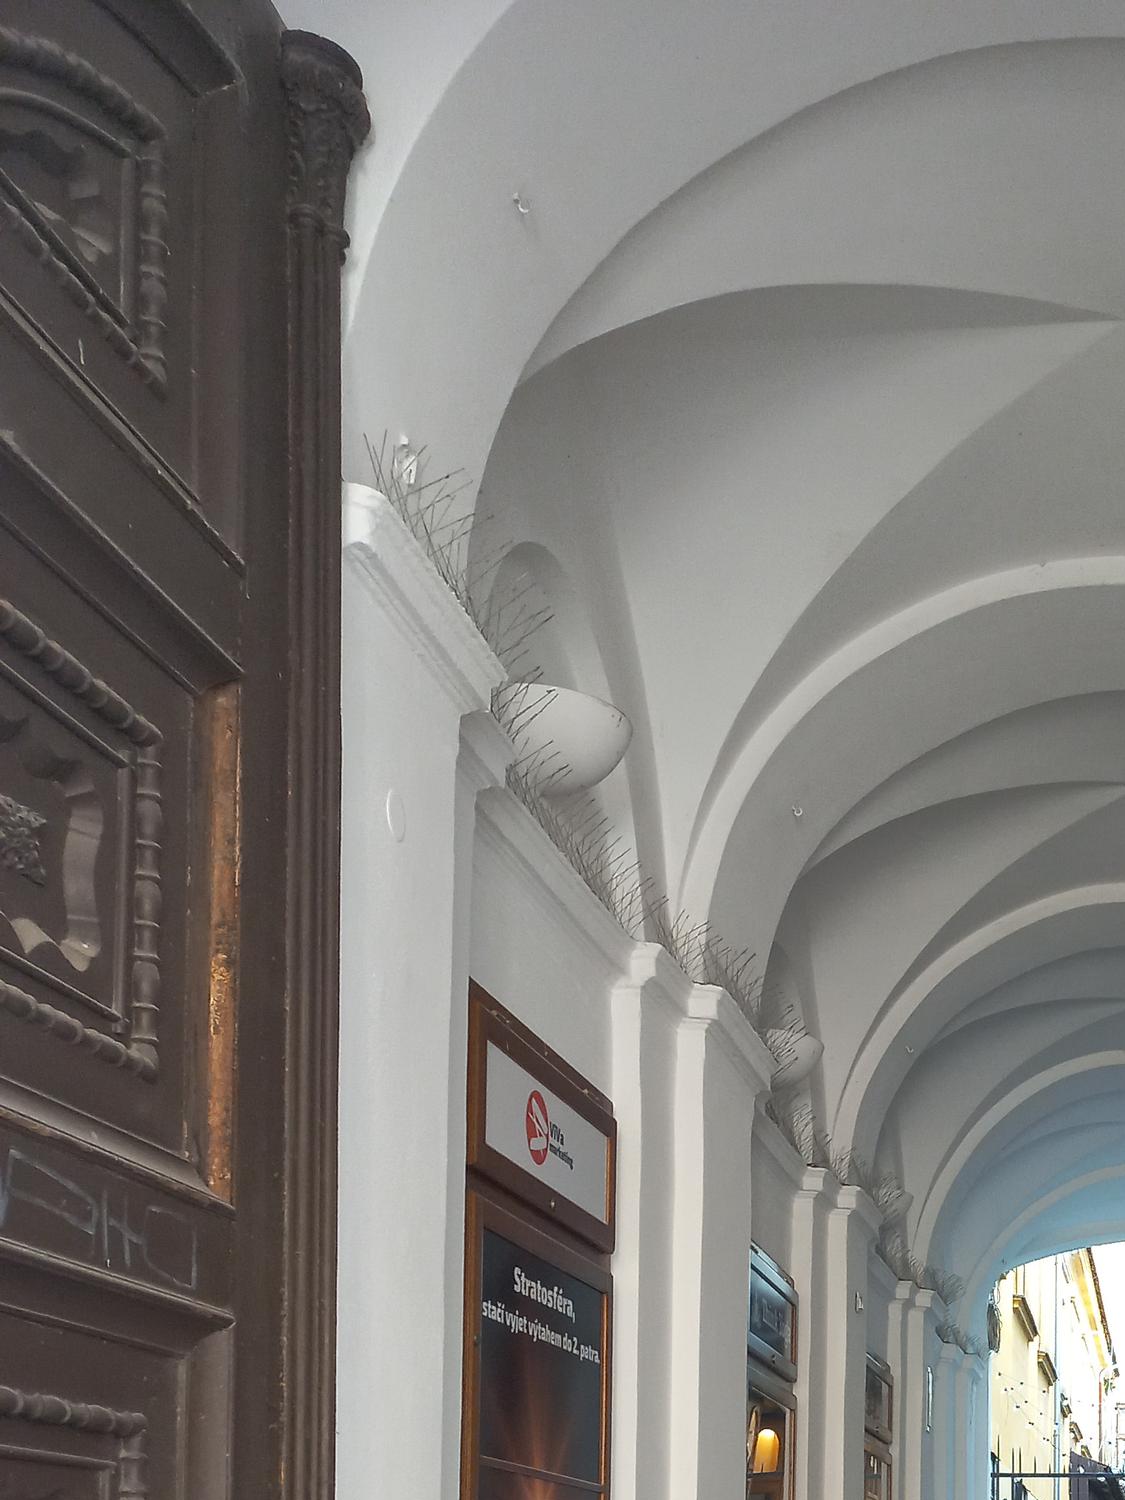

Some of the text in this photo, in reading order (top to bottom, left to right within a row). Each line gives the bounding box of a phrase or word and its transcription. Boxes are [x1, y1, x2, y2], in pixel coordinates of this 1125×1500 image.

[513, 1266, 576, 1323] Stratosféra,
[482, 1300, 600, 1364] stačí vyjet výtahem do 2. patra.
